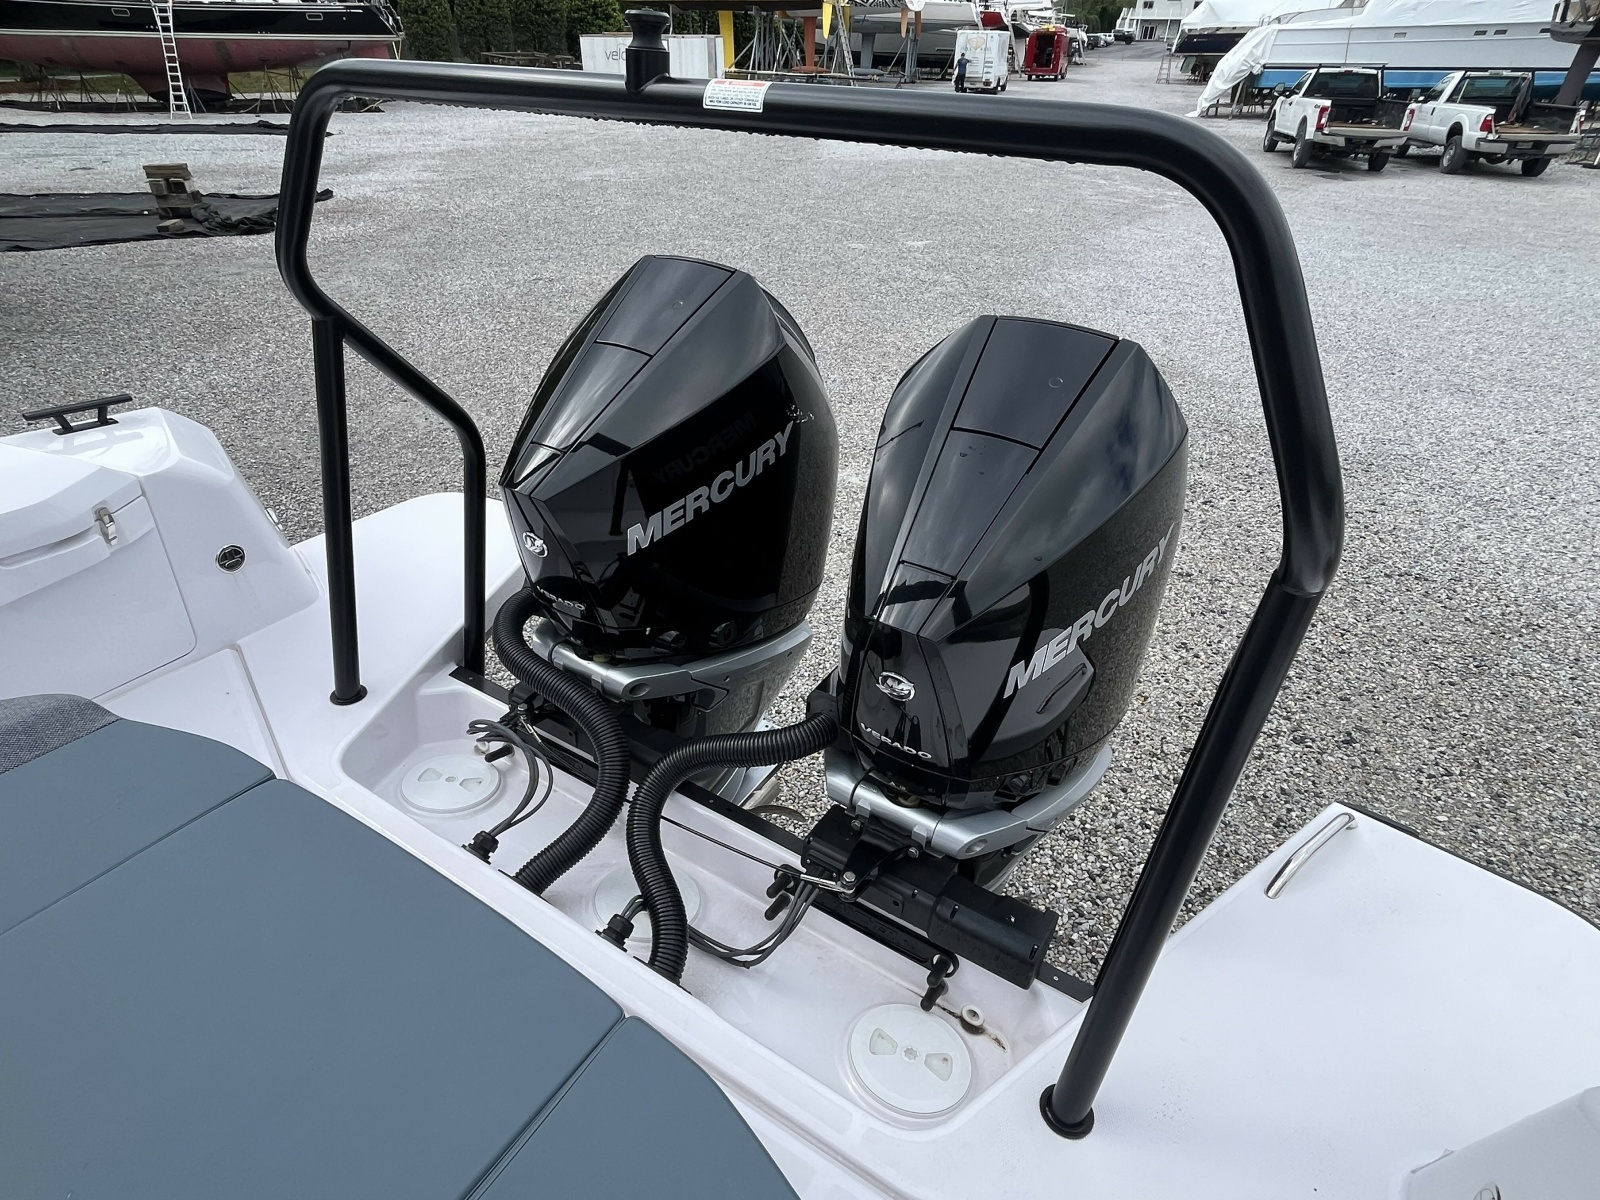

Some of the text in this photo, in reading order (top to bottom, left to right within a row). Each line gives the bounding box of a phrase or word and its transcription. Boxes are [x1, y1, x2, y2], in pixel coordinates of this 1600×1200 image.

[627, 421, 794, 557] MERCURY
[1003, 523, 1175, 700] MERCURY
[860, 722, 932, 759] VERADO
